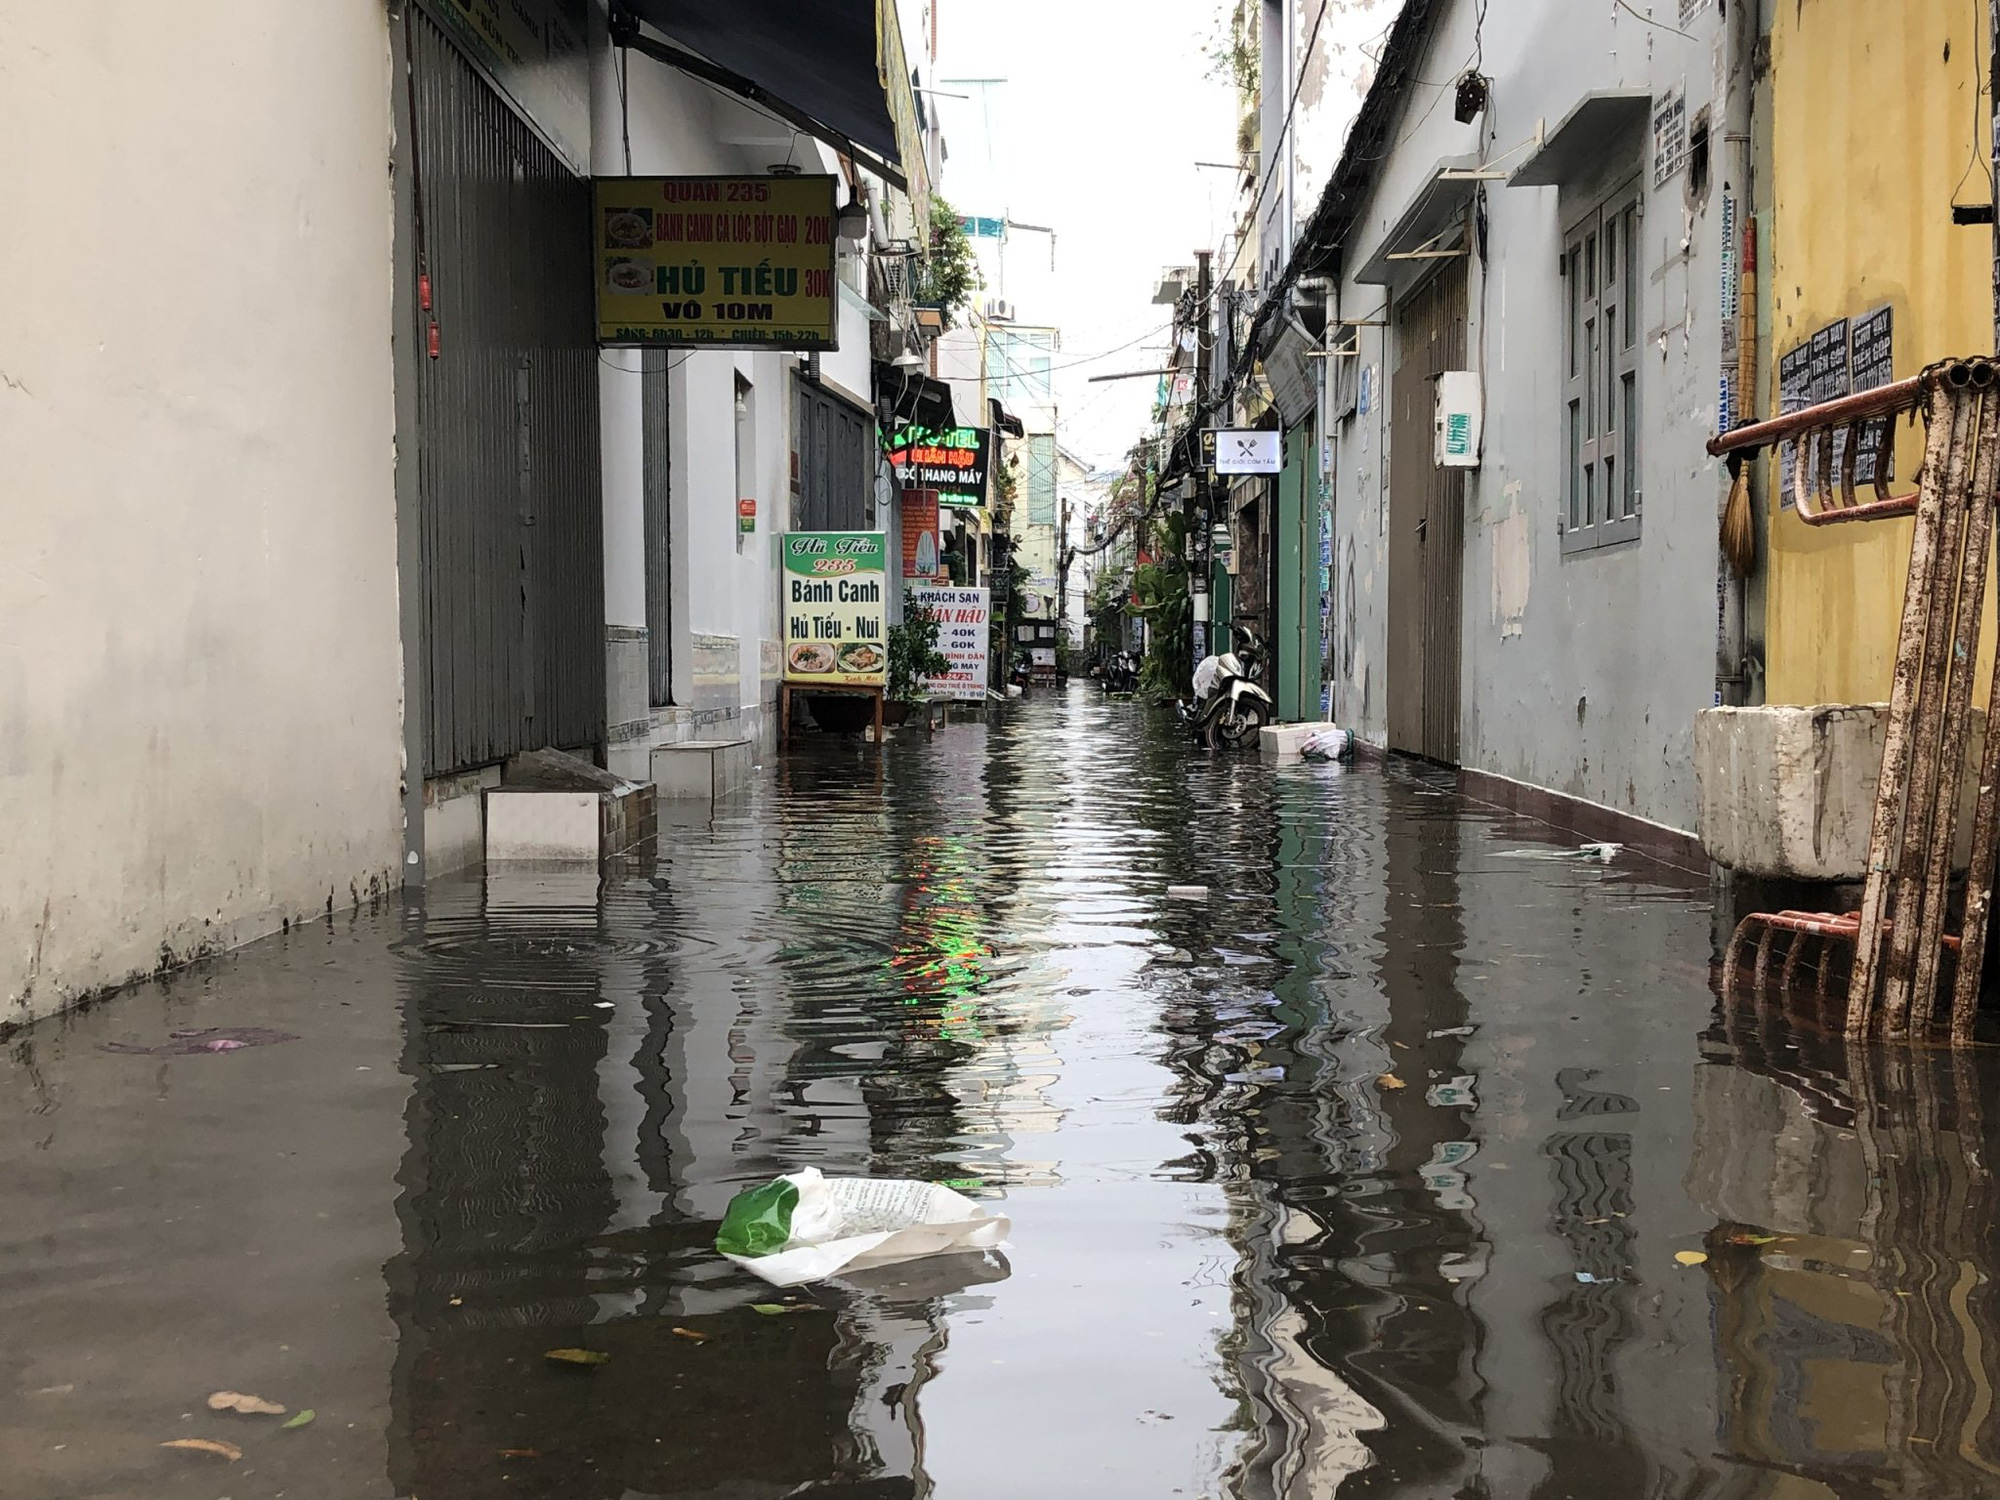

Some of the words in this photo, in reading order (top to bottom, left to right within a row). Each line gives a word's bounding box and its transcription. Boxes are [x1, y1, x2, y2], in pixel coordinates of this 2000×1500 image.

[727, 183, 768, 203] 235
[777, 214, 797, 249] GẠO
[805, 215, 830, 244] 20K
[656, 259, 705, 296] HỦ
[718, 257, 798, 297] TIẾU
[805, 269, 830, 298] 30K
[662, 299, 702, 320] VÔ
[712, 302, 773, 320] 10M
[958, 467, 983, 484] MÁY
[812, 558, 858, 573] 235
[791, 578, 833, 602] Bánh
[838, 579, 880, 602] Canh
[920, 590, 955, 603] KHÁCH
[958, 592, 980, 606] SẠN
[790, 613, 808, 639] Hủ
[812, 612, 841, 639] Tiếu
[856, 616, 879, 639] Nui
[954, 605, 986, 627] HẬU
[951, 628, 976, 637] 40K
[960, 662, 980, 670] MÁY
